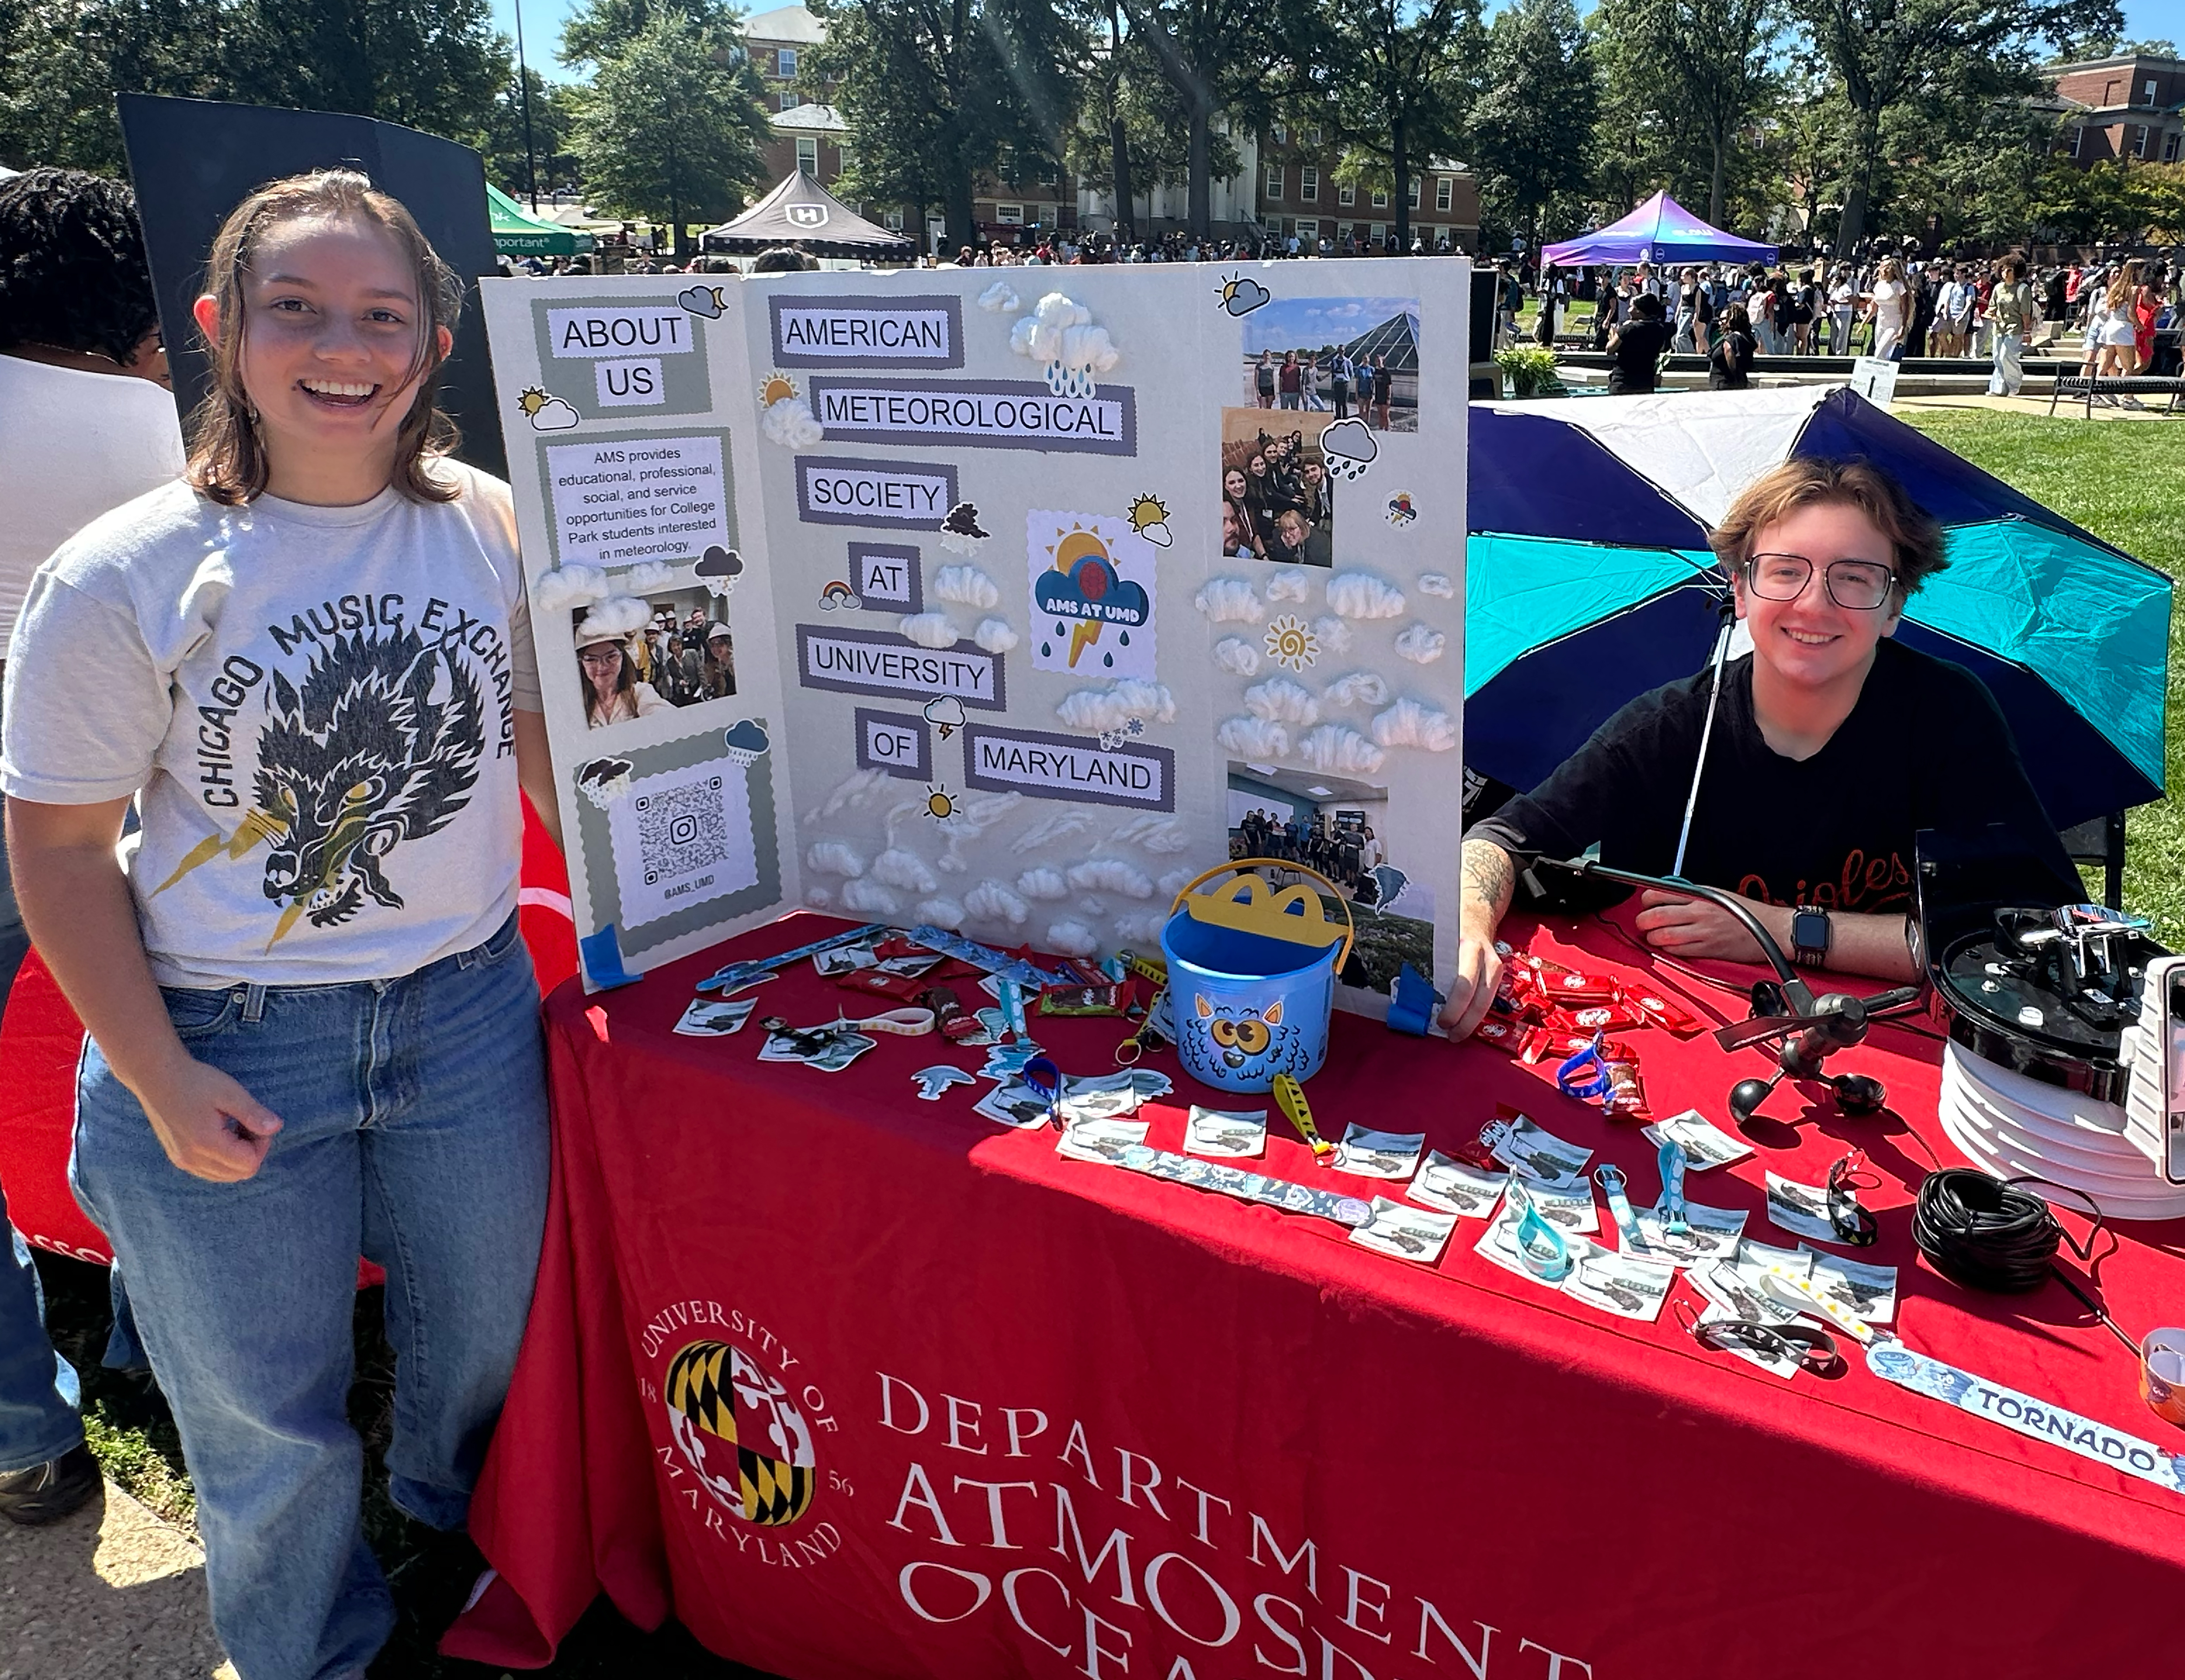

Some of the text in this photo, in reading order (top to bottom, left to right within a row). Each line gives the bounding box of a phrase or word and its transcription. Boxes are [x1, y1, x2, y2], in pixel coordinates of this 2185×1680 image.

[563, 318, 682, 349] ABOUT
[787, 319, 941, 348] AMERICAN
[607, 367, 653, 396] US
[827, 395, 1114, 436] METEOROLOGICAL
[594, 448, 680, 464] AMS provides
[559, 463, 716, 487] educational, professional,
[583, 484, 697, 504] social, and service
[814, 478, 940, 510] SOCIETY
[566, 501, 715, 526] opportunities for College
[569, 518, 716, 544] Park students interested
[599, 540, 691, 559] in meteorology.
[869, 565, 903, 592] AT
[1046, 598, 1140, 623] AMS AT UMD
[815, 644, 985, 691] UNIVERSITY
[198, 655, 264, 807] CHICAGO
[268, 594, 403, 656] MUSIC
[874, 733, 1151, 790] OF MARYLAND
[665, 875, 714, 900] @AMS_UMD
[1737, 849, 1909, 909] ioles
[642, 1300, 839, 1433] UNIVERSITY OF
[641, 1377, 657, 1403] 18
[1979, 1388, 2155, 1471] TORNADO
[829, 1470, 854, 1497] 56
[657, 1445, 841, 1568] MARYLAND
[875, 1372, 1593, 1680] DEPARTMENT
